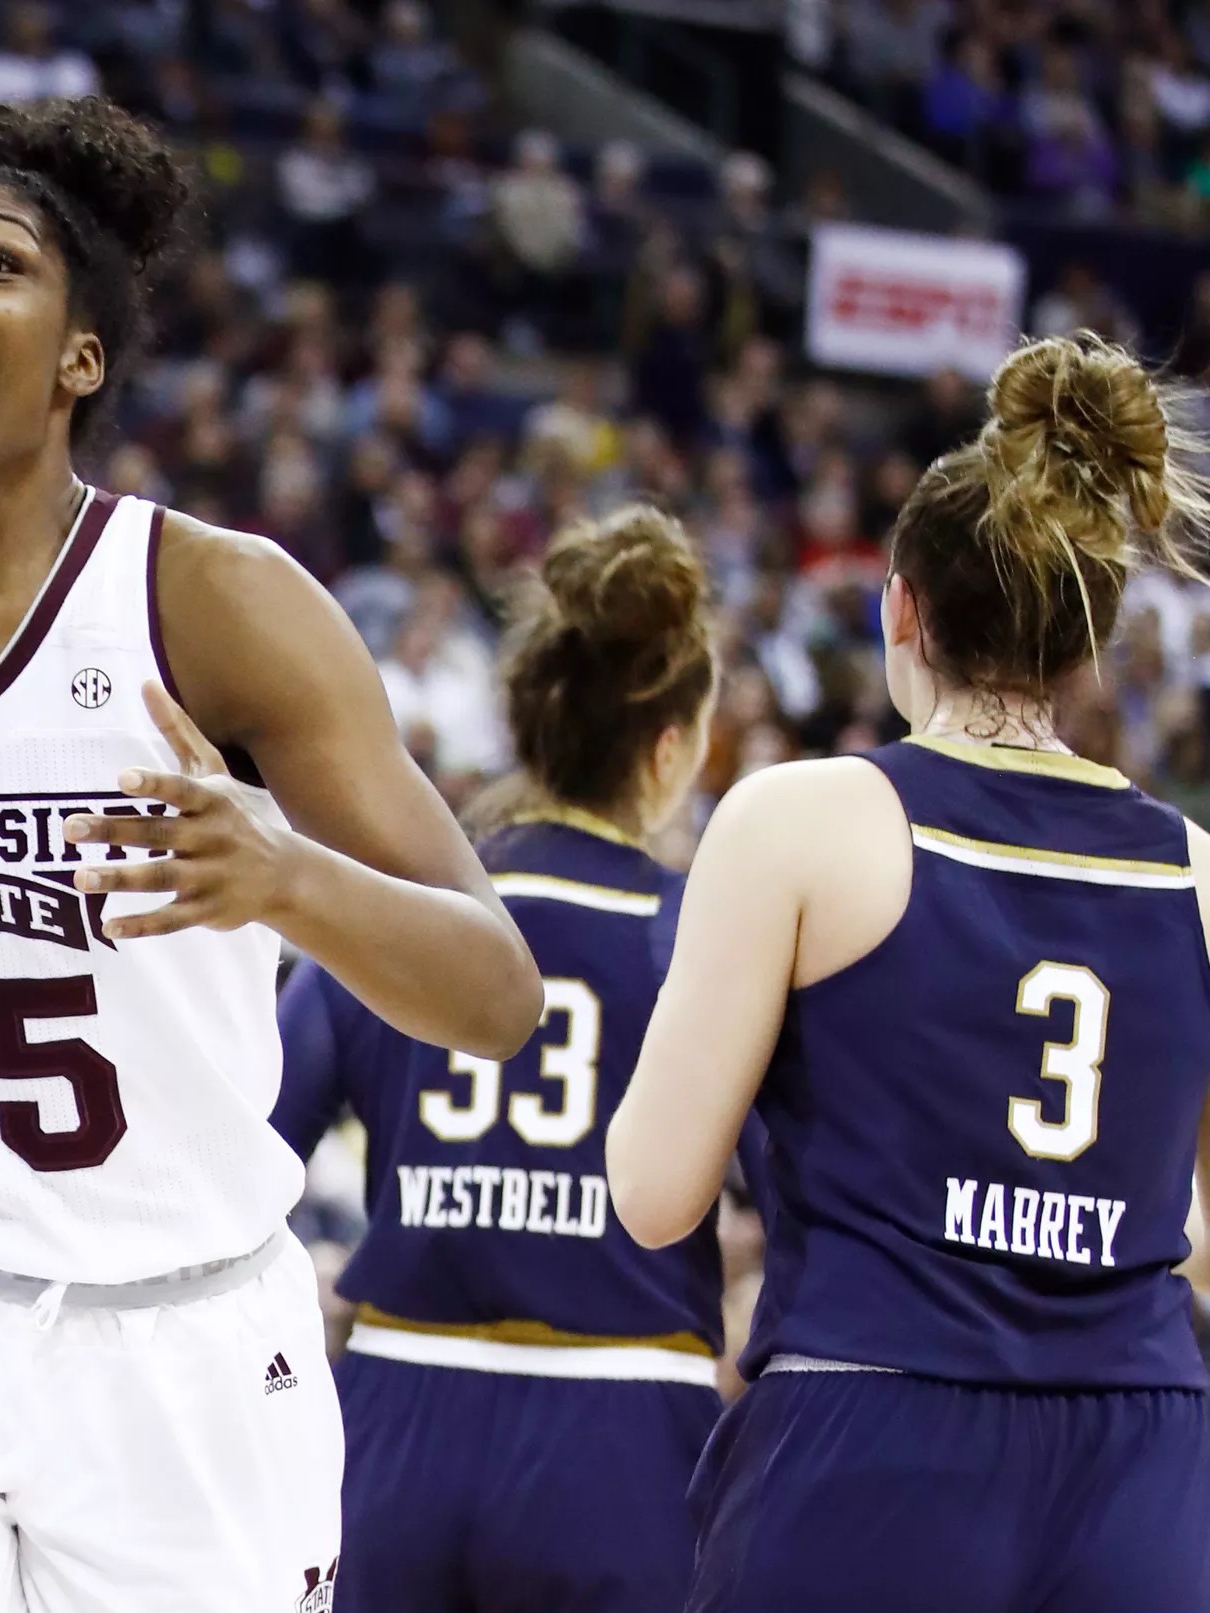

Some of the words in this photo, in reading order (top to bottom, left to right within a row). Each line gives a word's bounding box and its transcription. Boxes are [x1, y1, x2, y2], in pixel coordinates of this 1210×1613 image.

[71, 667, 112, 709] SEC
[1007, 960, 1111, 1162] 3
[396, 1165, 607, 1238] WESTBELD
[944, 1177, 1127, 1267] MABREY
[265, 1376, 298, 1395] addas
